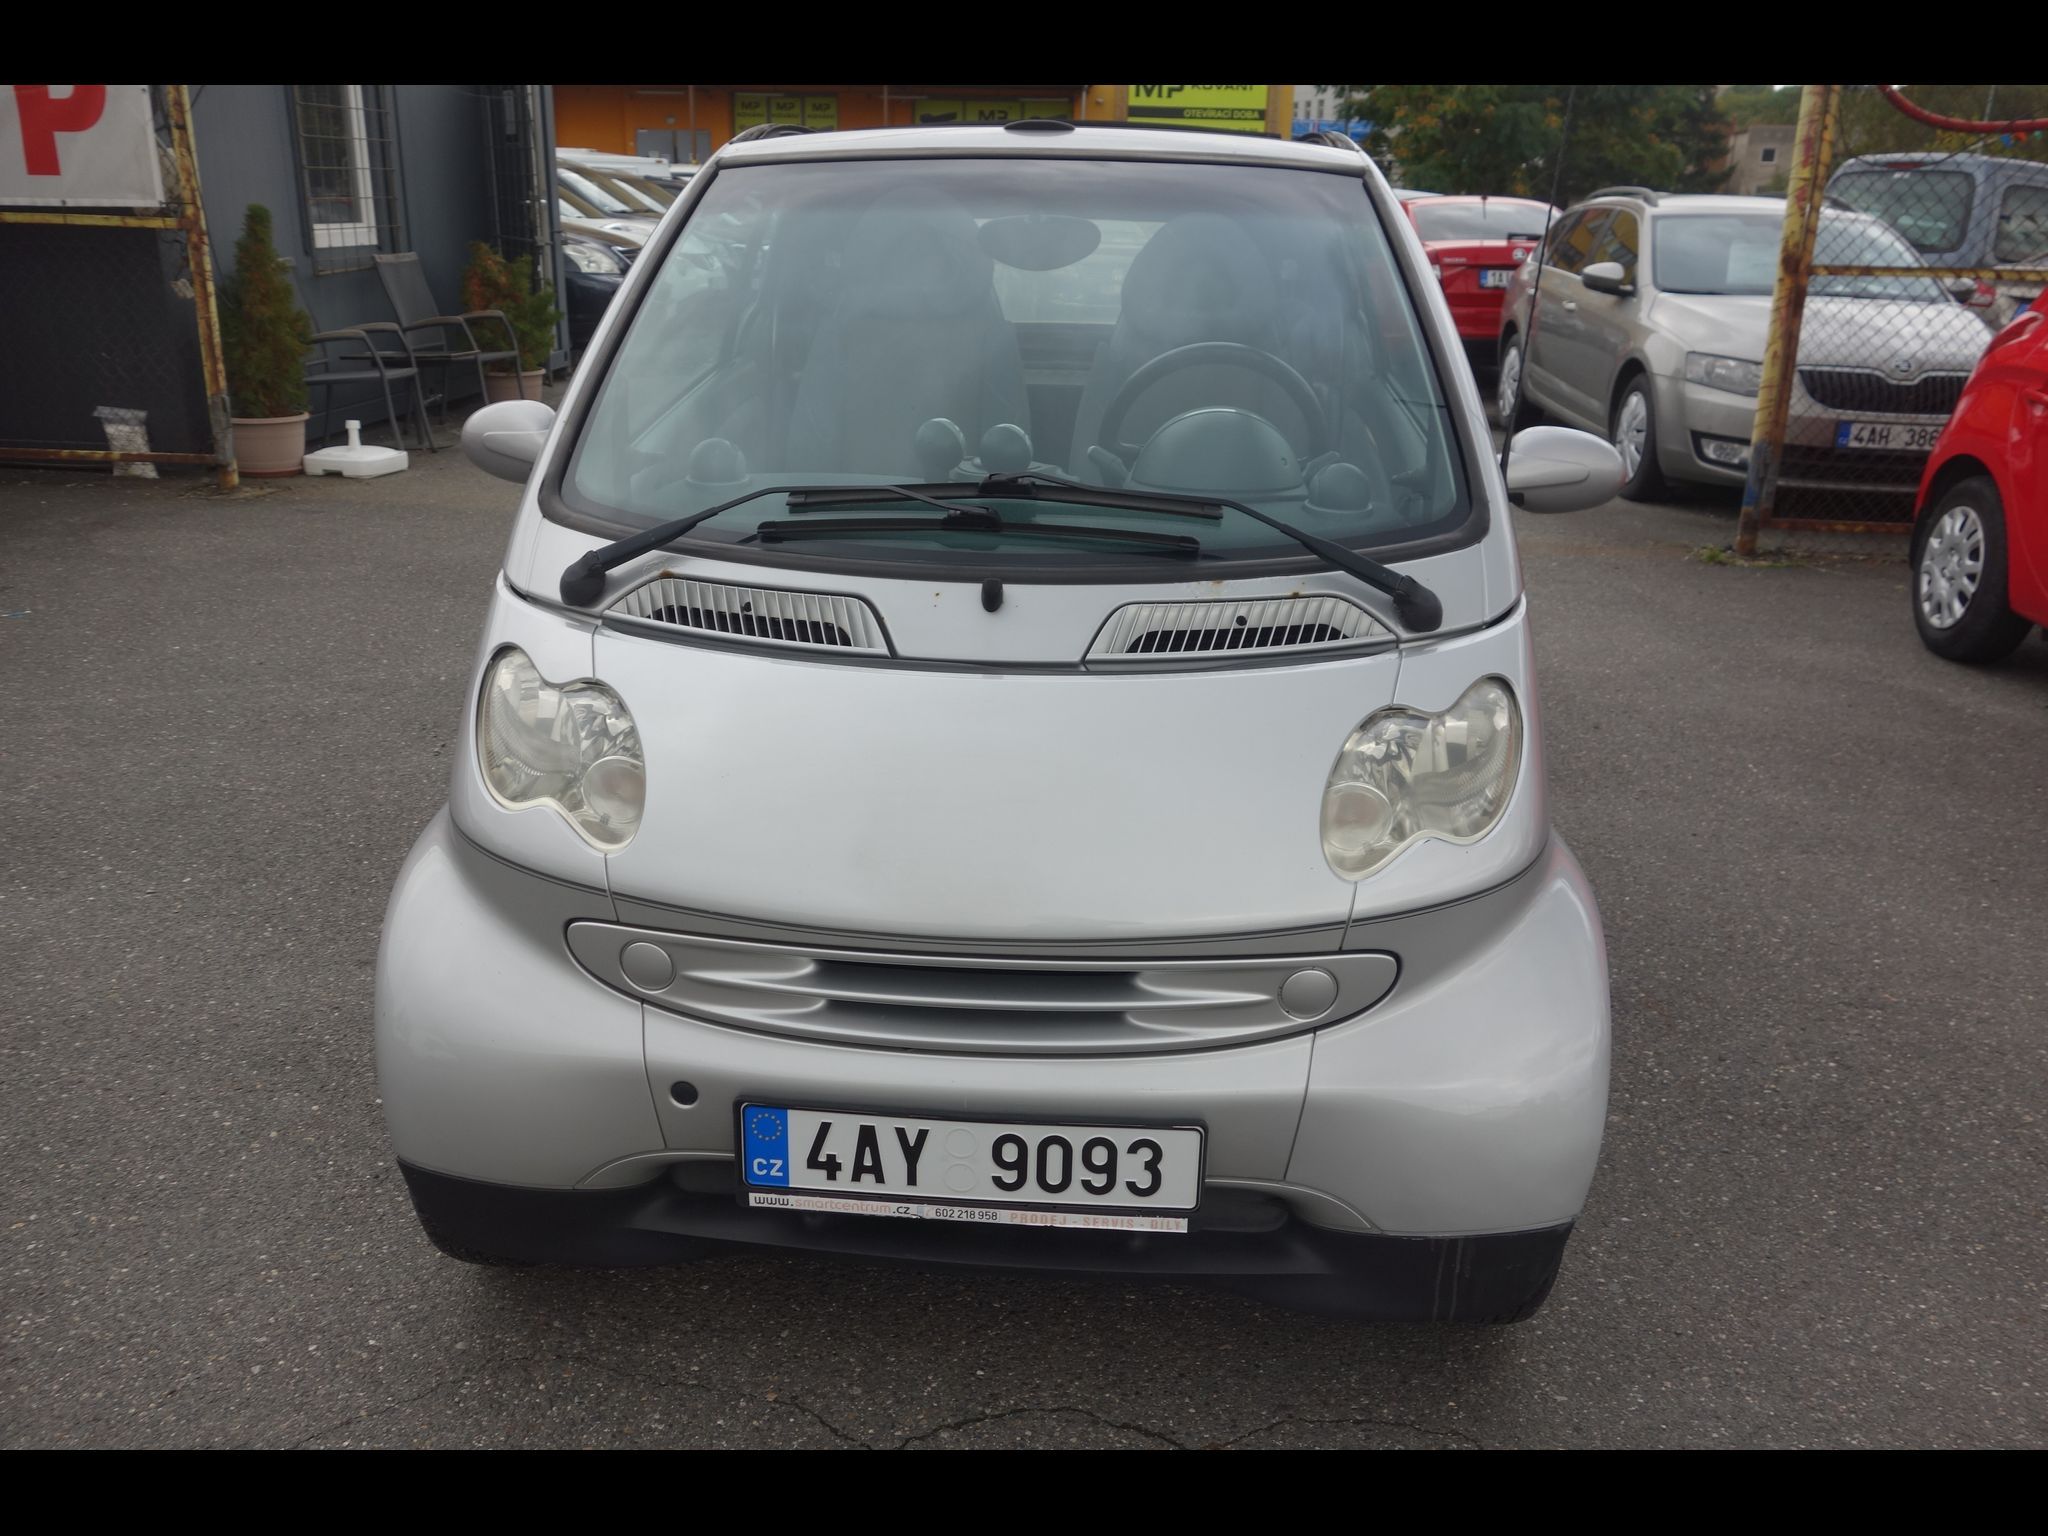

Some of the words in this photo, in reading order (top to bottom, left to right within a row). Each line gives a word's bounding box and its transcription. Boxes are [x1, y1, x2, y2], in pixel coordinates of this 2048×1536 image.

[13, 85, 107, 176] P
[1854, 426, 1891, 446] 4AH
[752, 1157, 784, 1177] CZ
[806, 1121, 930, 1187] 4AY
[991, 1133, 1164, 1198] 9093
[754, 1196, 911, 1215] www.smartcentrum.cz
[935, 1208, 955, 1219] 602
[957, 1210, 976, 1220] 218
[978, 1211, 998, 1221] 958
[1009, 1212, 1068, 1226] PRODEJ
[1082, 1215, 1135, 1229] SERVIS
